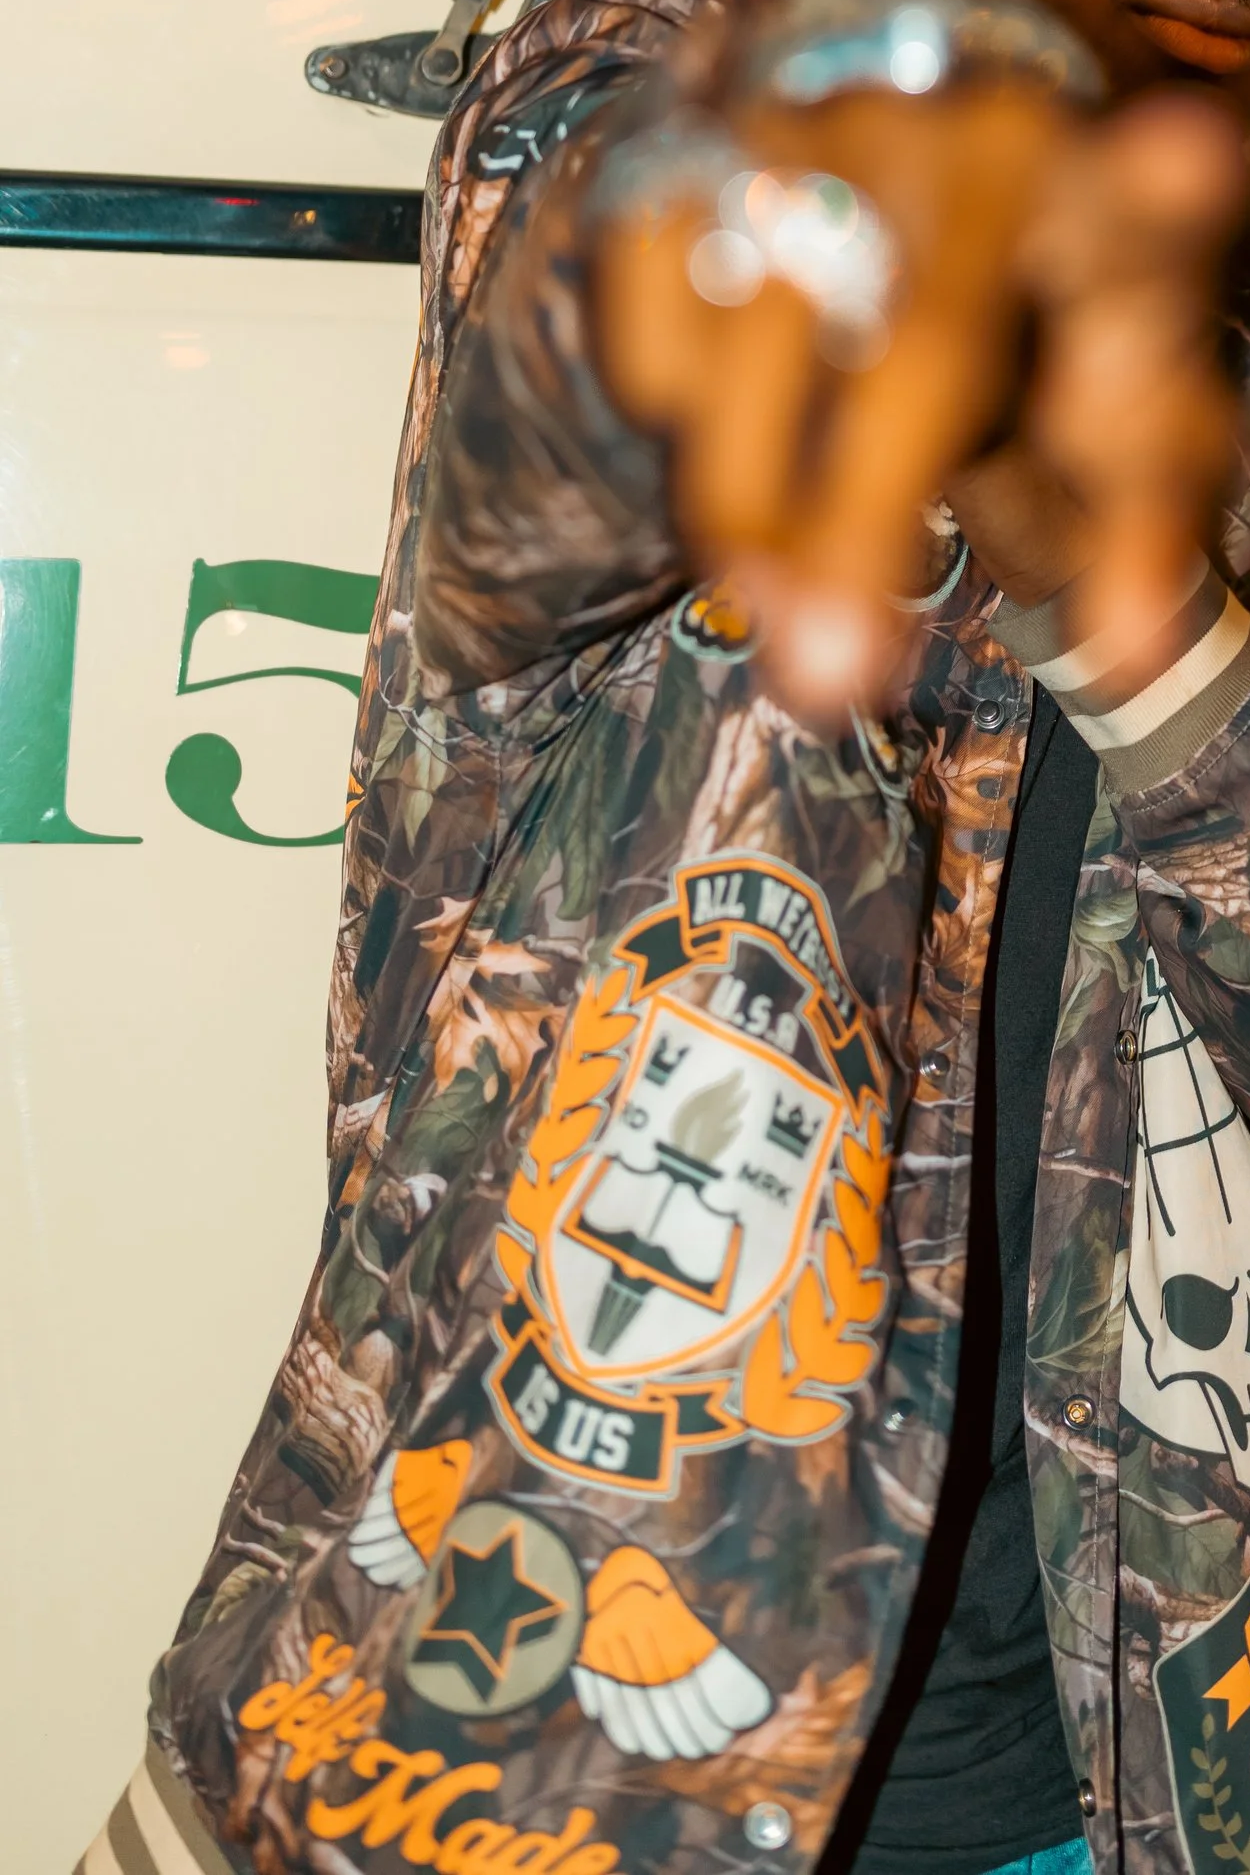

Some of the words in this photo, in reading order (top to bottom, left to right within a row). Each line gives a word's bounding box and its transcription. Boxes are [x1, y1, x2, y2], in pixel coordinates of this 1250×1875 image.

[692, 873, 746, 926] ALL
[554, 1398, 636, 1472] US
[307, 1739, 622, 1875] Made
